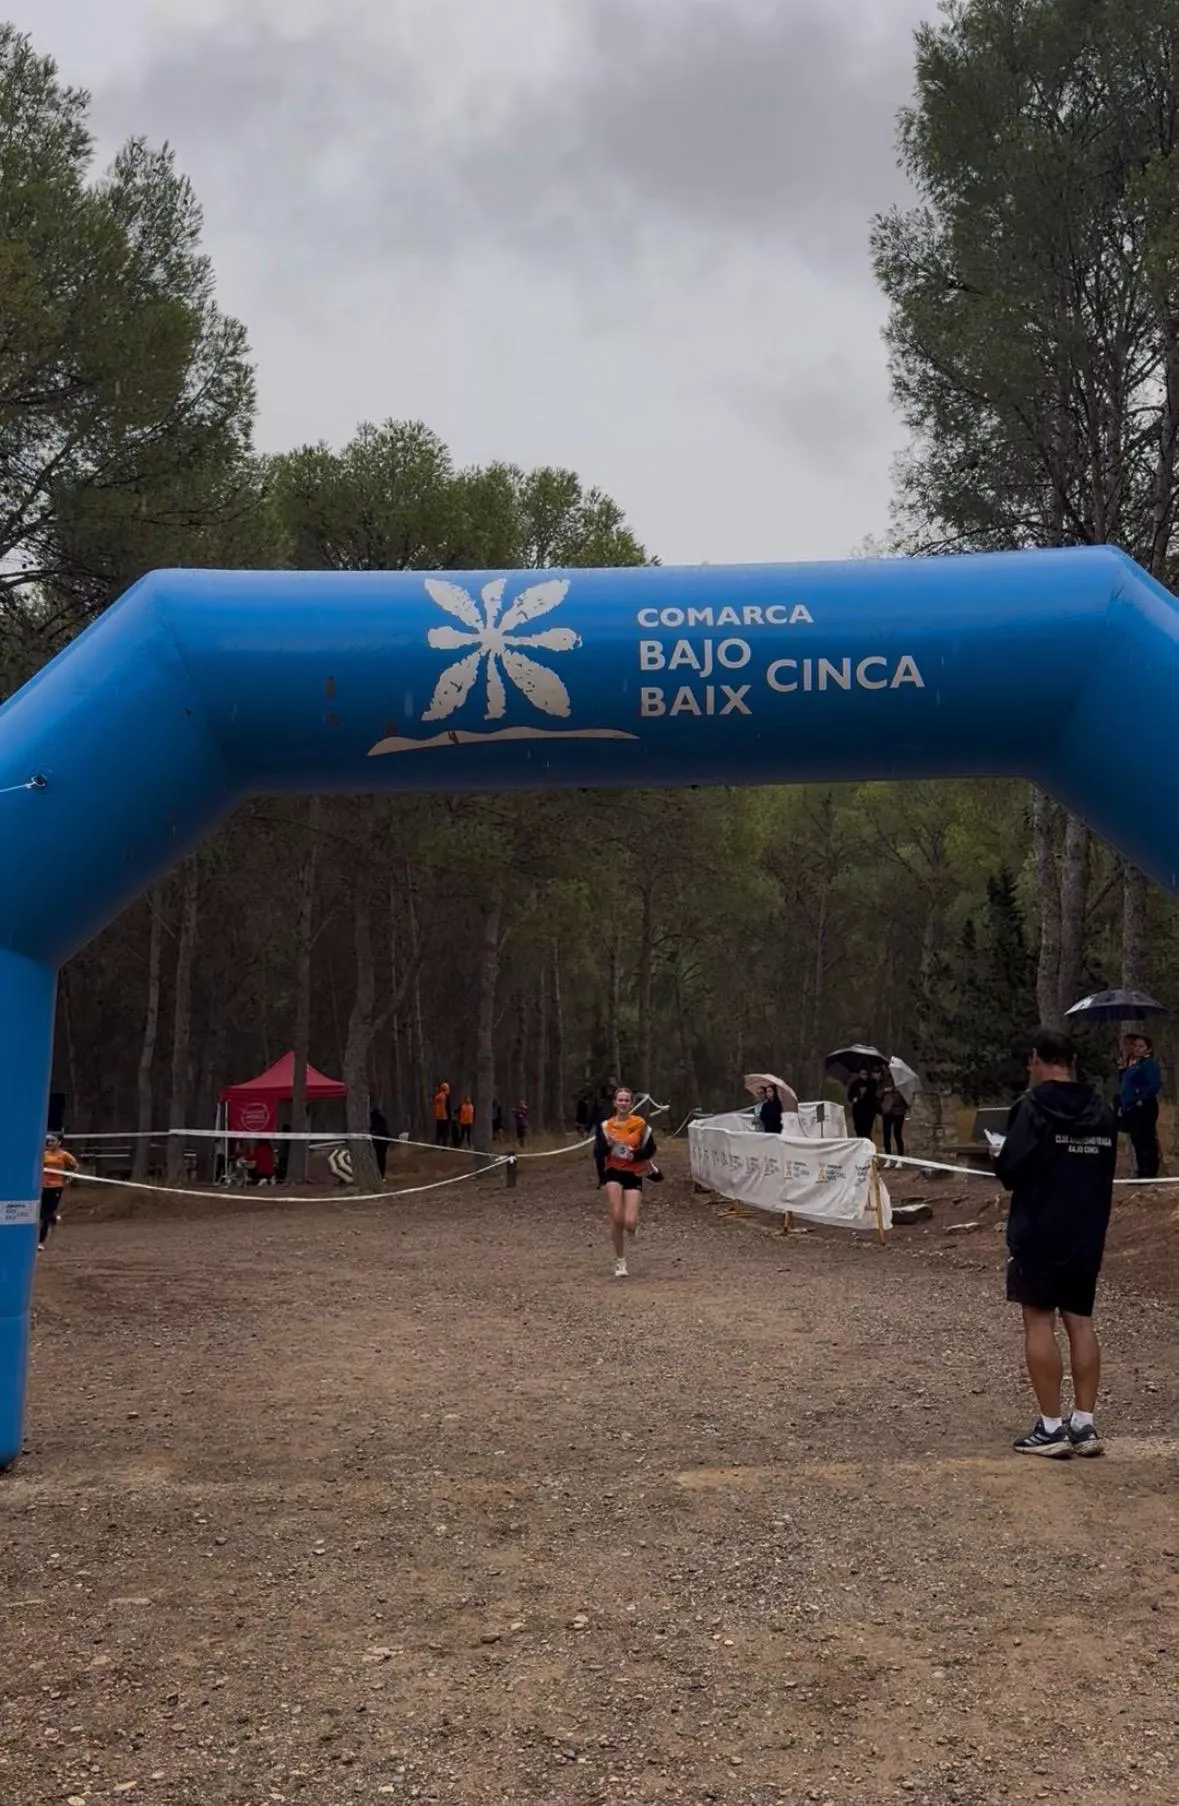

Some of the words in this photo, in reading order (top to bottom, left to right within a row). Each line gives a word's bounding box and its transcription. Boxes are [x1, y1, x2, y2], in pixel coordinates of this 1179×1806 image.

[637, 604, 814, 628] COMARCA
[639, 638, 751, 678] BAJO
[766, 655, 925, 692] CINCA
[640, 684, 752, 717] BAIX
